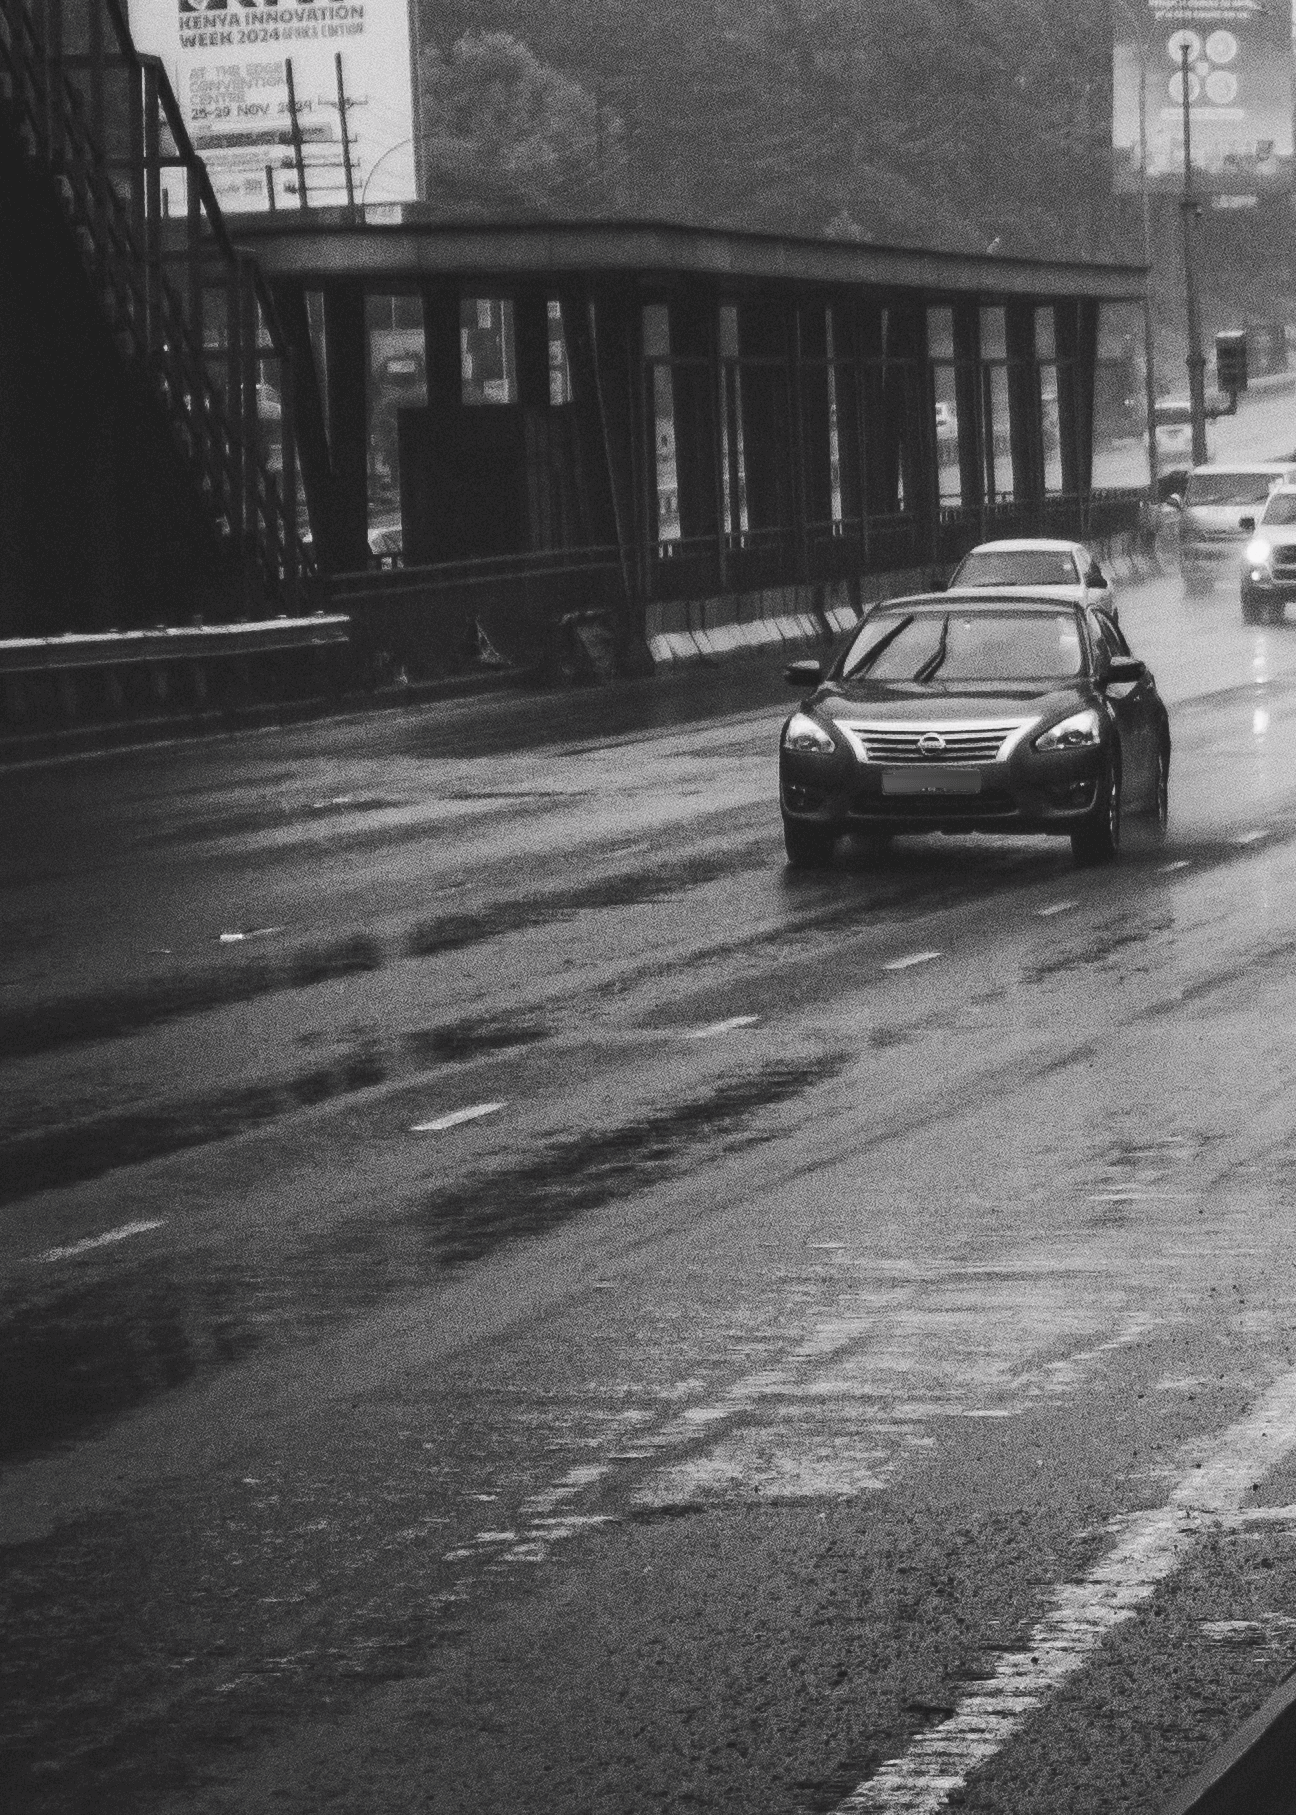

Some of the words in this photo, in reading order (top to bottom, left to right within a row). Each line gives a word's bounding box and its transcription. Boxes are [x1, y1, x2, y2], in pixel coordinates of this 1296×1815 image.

[179, 12, 240, 31] KENYA
[245, 5, 365, 27] INNOVATION
[180, 31, 233, 49] WEEK
[237, 27, 280, 45] 2024
[216, 65, 240, 78] THE
[246, 61, 283, 76] EDGE
[190, 91, 245, 106] CENTRE
[237, 103, 270, 117] NOV
